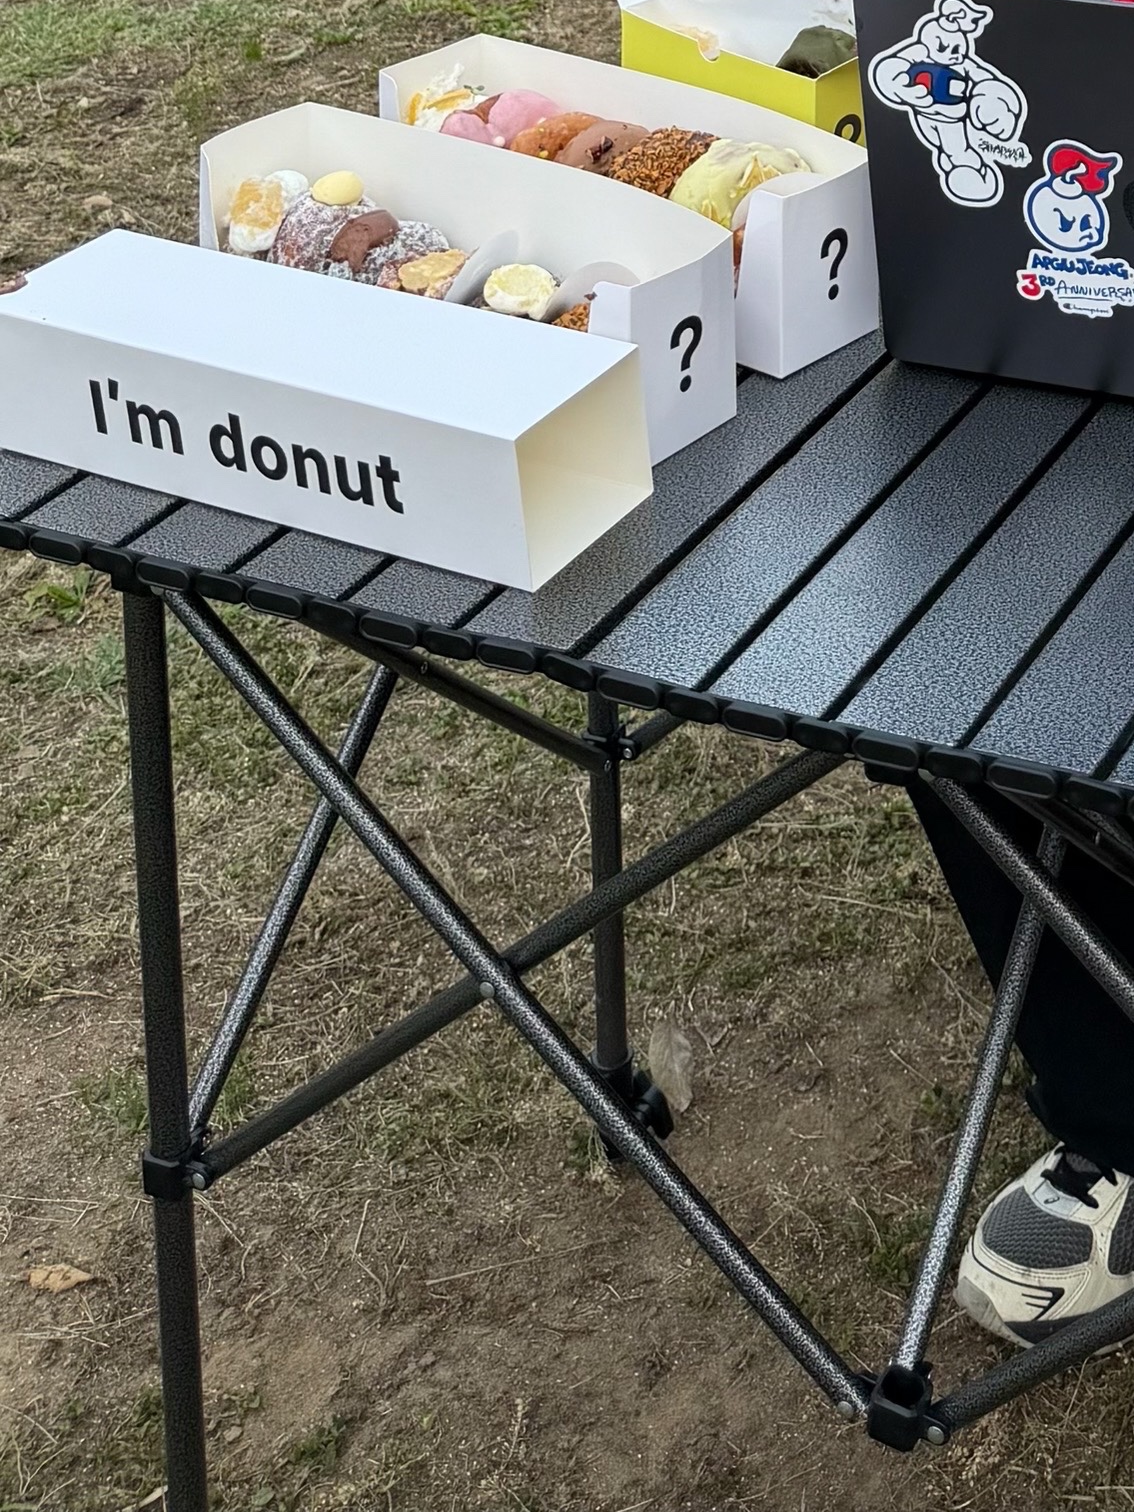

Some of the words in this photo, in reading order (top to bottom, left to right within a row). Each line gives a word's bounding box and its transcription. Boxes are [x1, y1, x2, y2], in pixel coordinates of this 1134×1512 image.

[820, 227, 849, 301] ?
[670, 315, 703, 393] ?
[89, 378, 184, 455] I'm
[209, 412, 405, 515] donut
